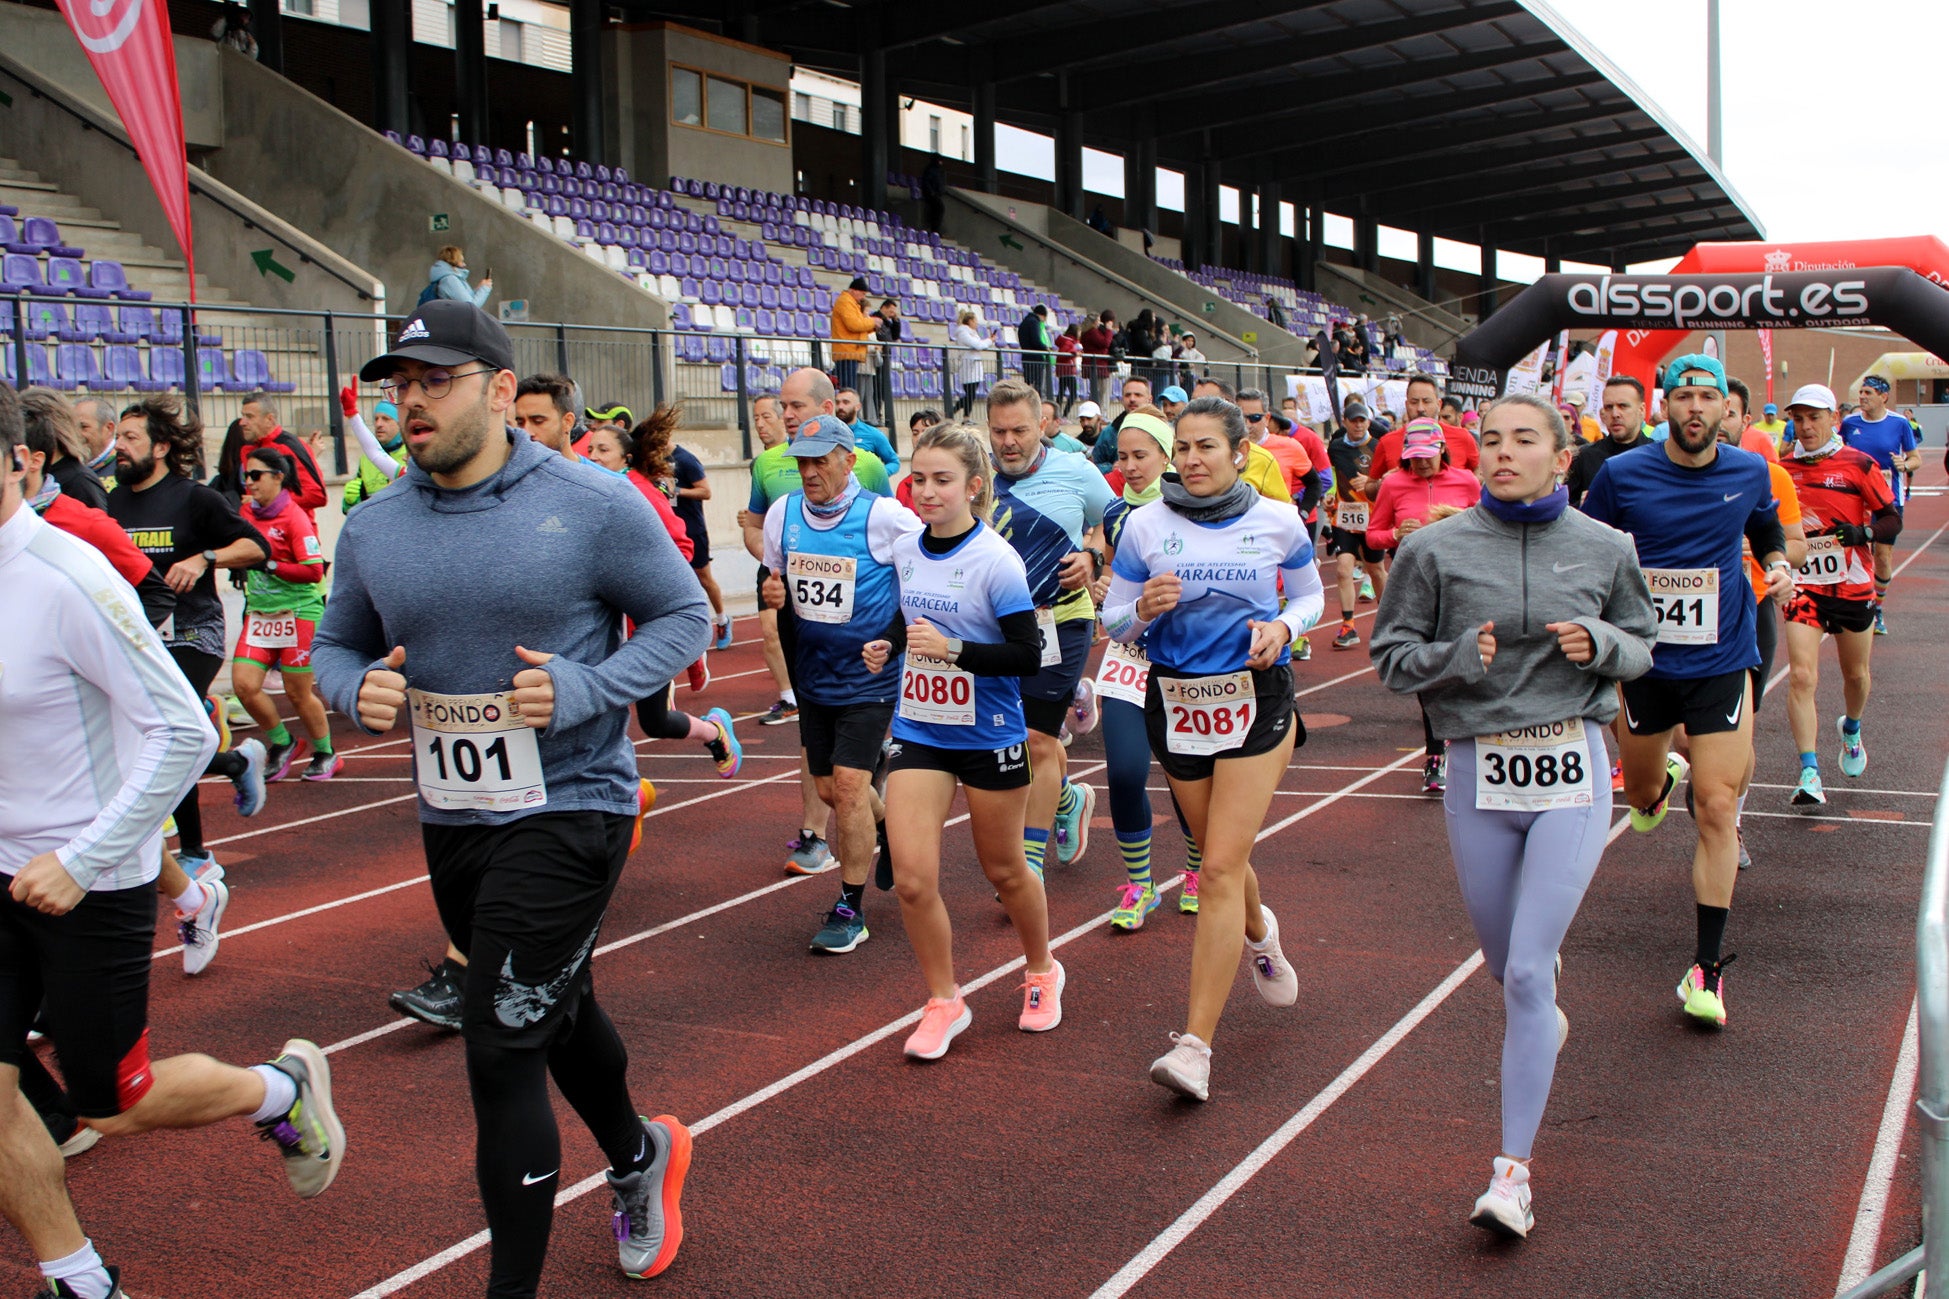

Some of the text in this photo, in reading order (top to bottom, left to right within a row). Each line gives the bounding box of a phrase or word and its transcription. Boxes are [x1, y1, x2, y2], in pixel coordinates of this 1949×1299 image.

[1568, 275, 1868, 328] alssport.es
[1687, 320, 1746, 329] RUNNING
[1757, 320, 1794, 328] TRAIL
[1805, 318, 1871, 328] OUTDOOR
[399, 330, 430, 342] adidas
[1342, 513, 1365, 524] 516
[1808, 541, 1832, 551] NDO
[800, 560, 842, 573] FONDO
[1652, 576, 1703, 588] FONDO
[797, 580, 843, 607] 534
[903, 595, 958, 613] ARACENA
[1653, 598, 1703, 626] 541
[252, 621, 294, 637] 2095
[1102, 660, 1150, 692] 208
[904, 670, 970, 705] 2080
[1181, 683, 1237, 698] FONDO
[426, 702, 500, 722] FONDO
[1172, 703, 1250, 735] 2081
[429, 736, 512, 782] 101
[1485, 751, 1584, 787] 3088
